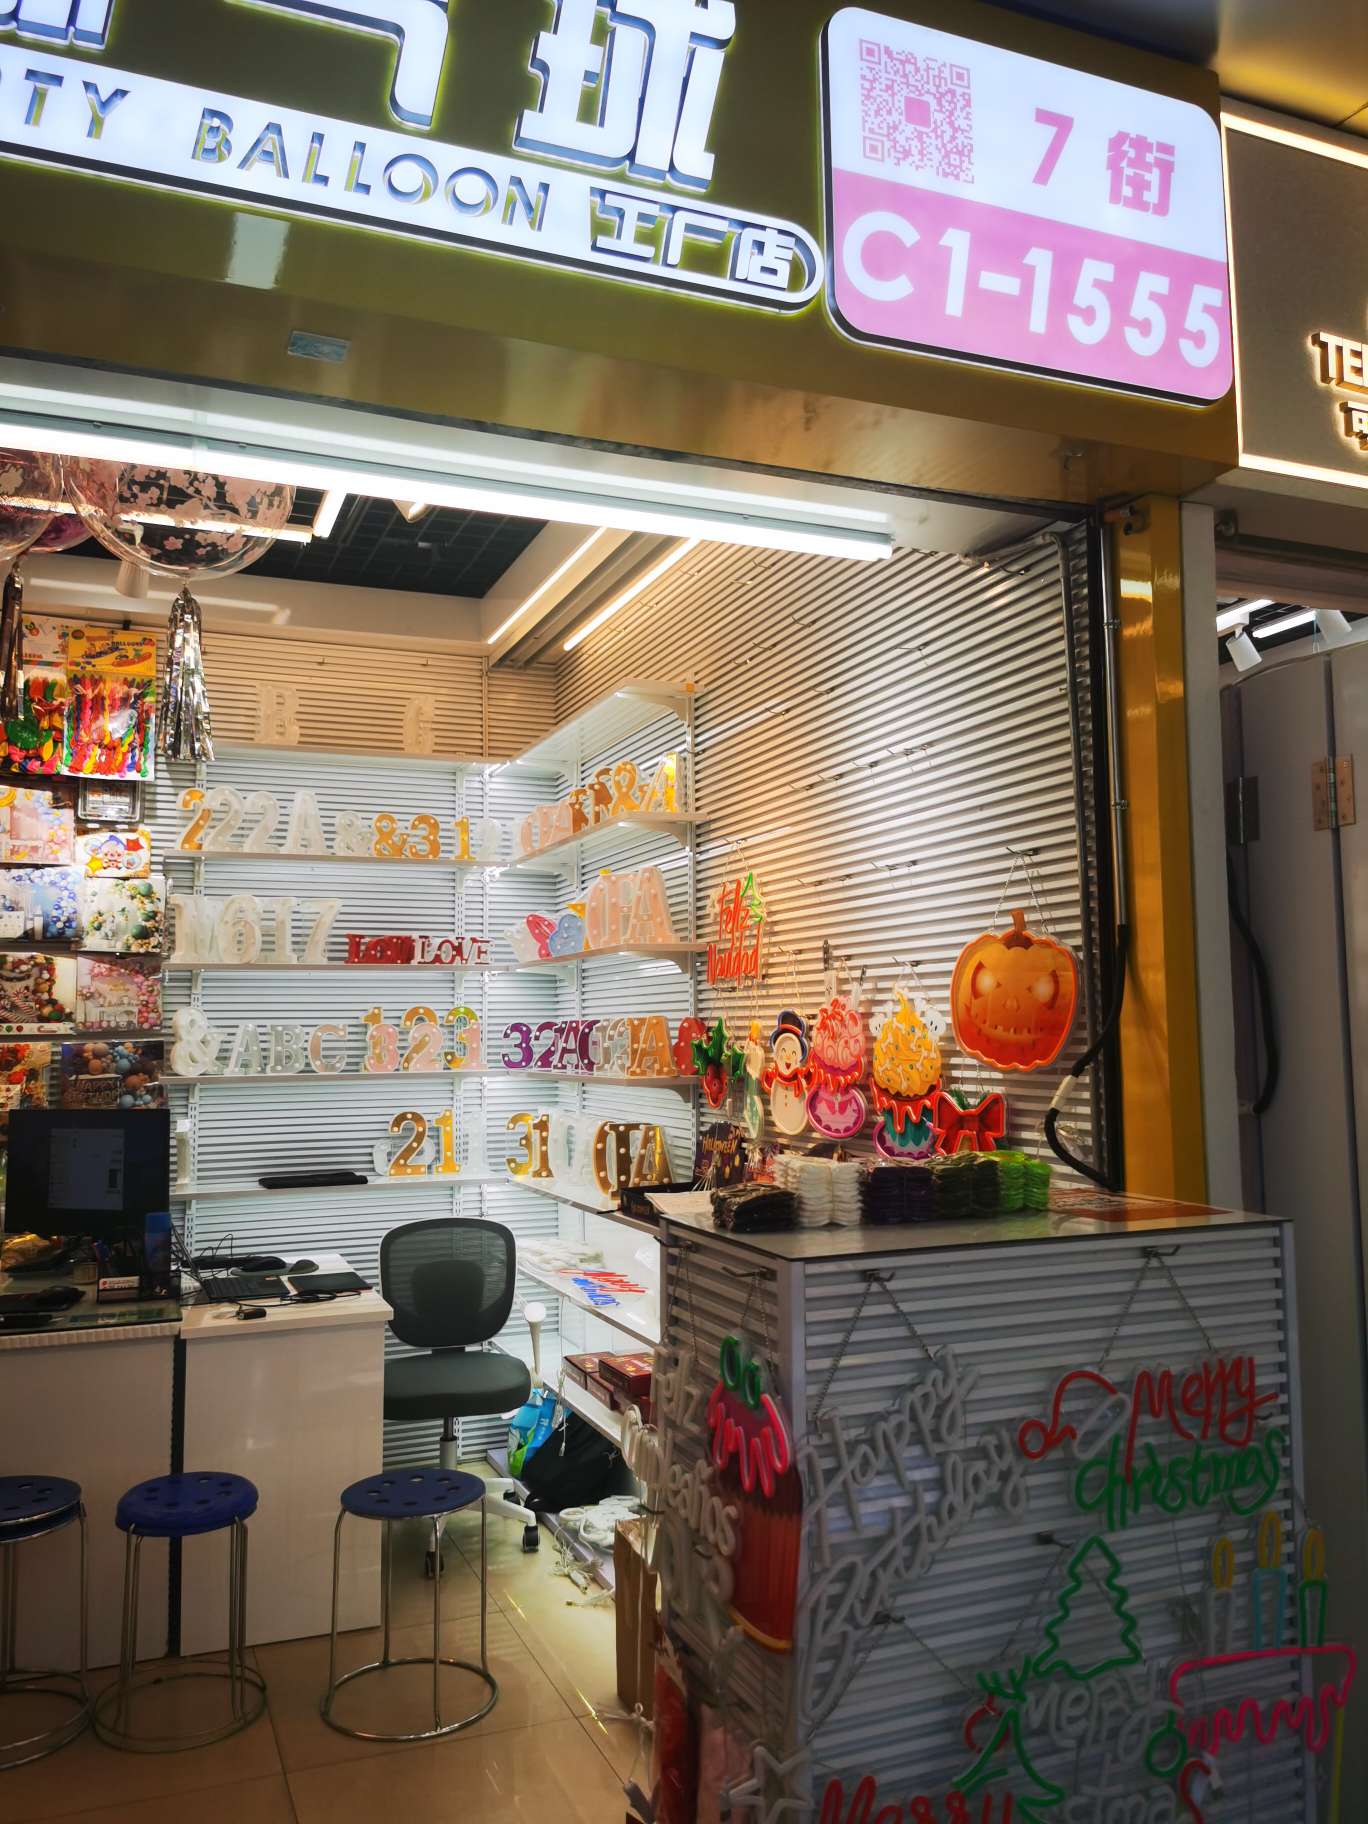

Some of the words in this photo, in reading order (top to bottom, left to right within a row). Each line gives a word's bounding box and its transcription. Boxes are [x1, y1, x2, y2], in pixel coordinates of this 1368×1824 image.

[0, 66, 131, 140] TY
[191, 106, 551, 232] BALLOON
[589, 185, 797, 290] 工厂店
[842, 210, 1224, 369] C1-1555
[1310, 330, 1368, 396] TE
[1074, 1427, 1287, 1532] Christmas
[1124, 1355, 1280, 1483] Merry
